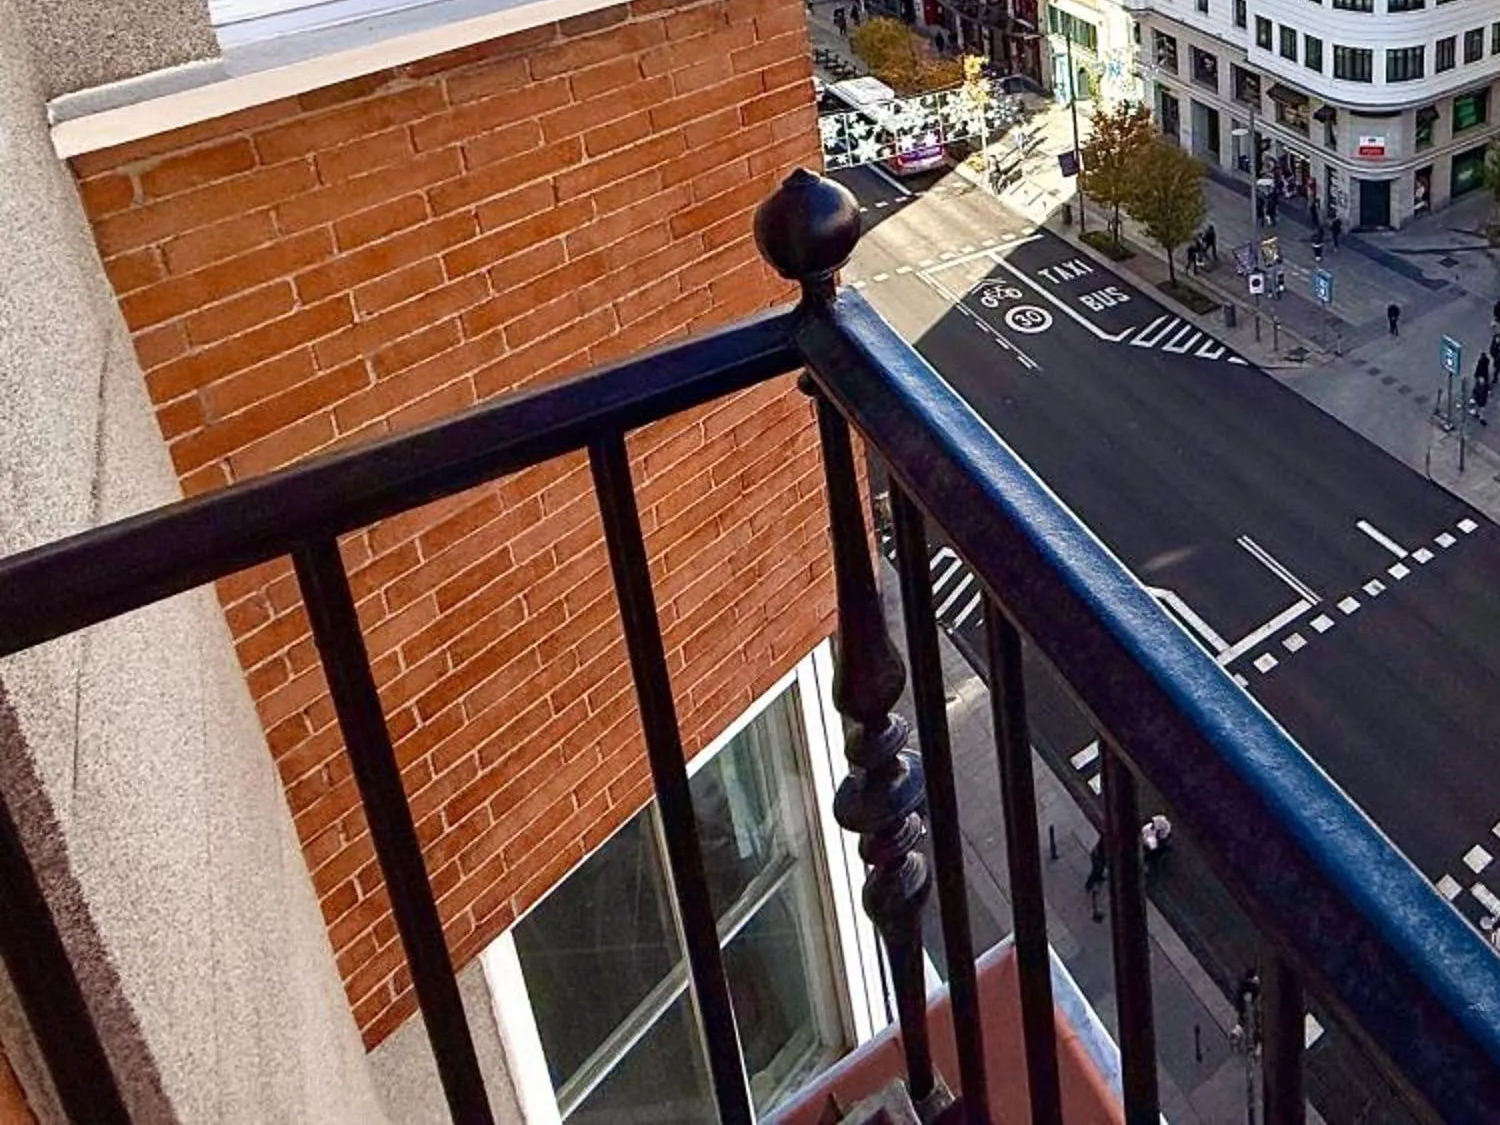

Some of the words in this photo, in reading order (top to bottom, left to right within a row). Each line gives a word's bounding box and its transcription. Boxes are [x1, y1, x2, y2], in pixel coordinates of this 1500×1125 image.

[1037, 258, 1094, 284] TAXI
[1079, 286, 1131, 312] BUS
[1013, 310, 1044, 328] 30
